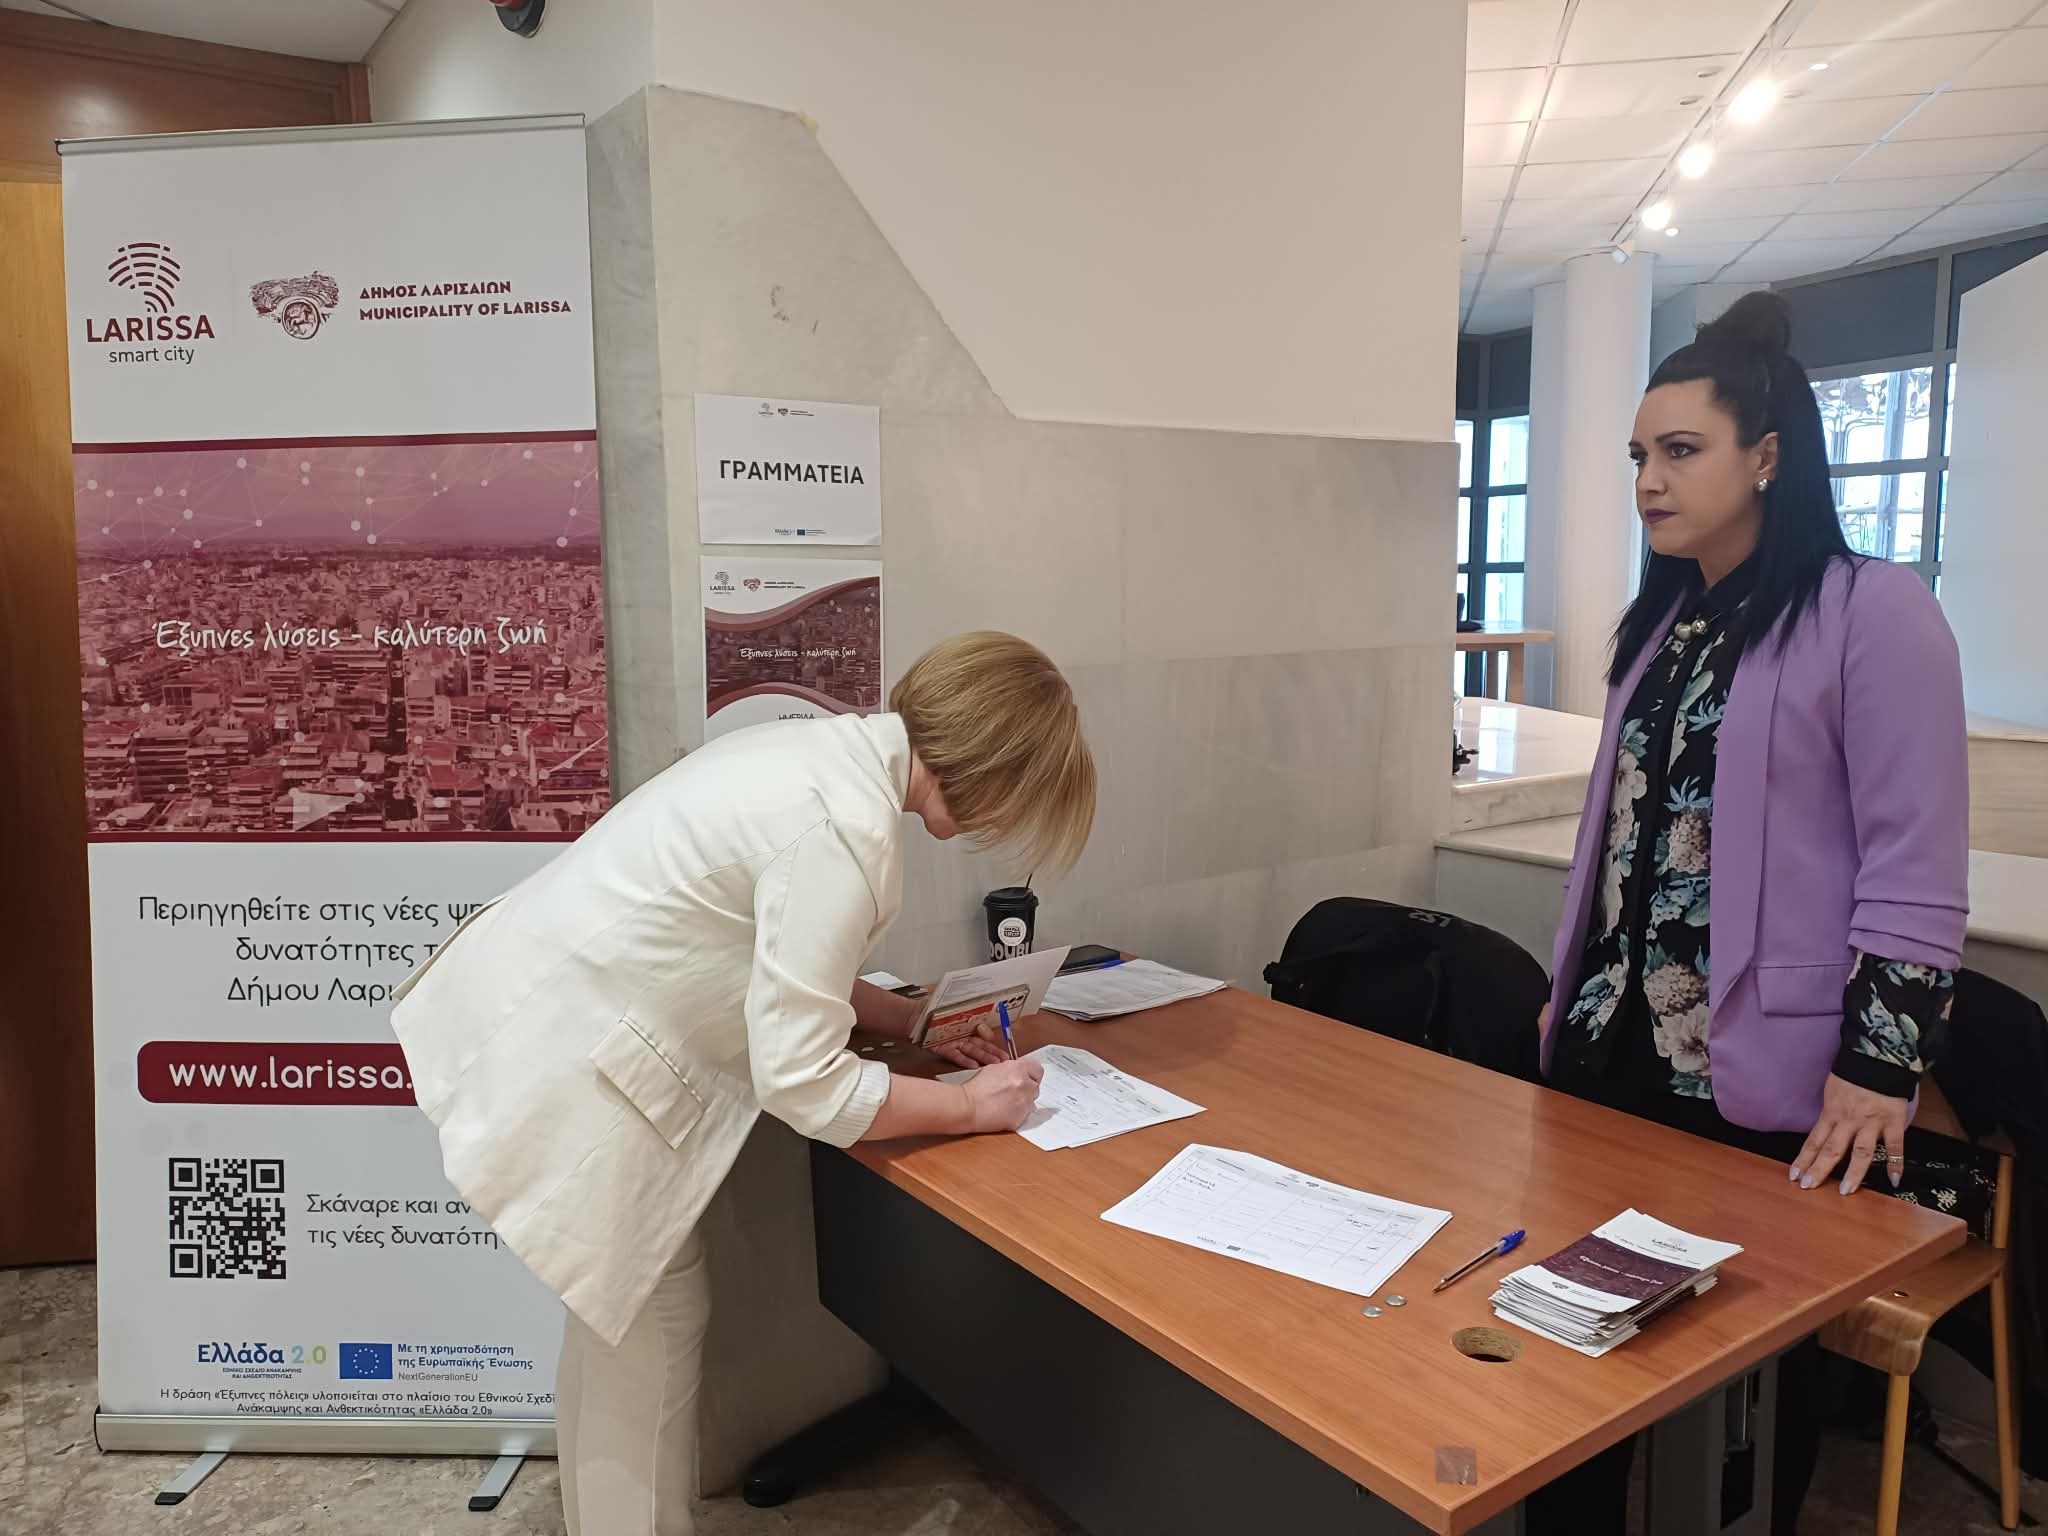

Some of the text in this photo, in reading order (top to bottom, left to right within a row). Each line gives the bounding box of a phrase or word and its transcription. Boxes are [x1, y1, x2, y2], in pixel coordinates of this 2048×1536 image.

[359, 280, 512, 301] ΔΗΜΟΣ ΛΑΡΙΣΑΙΩΝ
[359, 300, 572, 322] MUNICIPALITY OF LARISSA
[86, 313, 216, 343] LARISSA
[108, 345, 195, 366] smart city
[719, 459, 865, 485] ΓΡΑΜΜΑΤΕΙΑ
[150, 619, 256, 655] Έξυπνες
[263, 620, 342, 652] λύσεις
[372, 617, 487, 655] καλύτερη
[495, 616, 548, 654] ζωή
[138, 895, 311, 929] Περιηγηθείτε
[318, 901, 376, 928] στις
[382, 895, 440, 928] νέες
[235, 935, 416, 969] δυνατότητες
[226, 977, 320, 1006] Δήμου
[305, 1193, 400, 1217] Σκάναρε
[404, 1199, 438, 1214] και
[306, 1227, 337, 1249] τις
[341, 1223, 385, 1249] νέες
[197, 1342, 327, 1364] Ελλάδα 2.0
[398, 1344, 514, 1356] Με τη χρηματοδότηση
[398, 1358, 533, 1370] της Ευρωπαϊκής Ένωσης
[398, 1373, 478, 1382] NextGenerationEU
[160, 1389, 170, 1399] Η
[172, 1389, 211, 1400] δράση
[312, 1390, 378, 1401] υλοποιείται
[381, 1393, 403, 1401] στο
[406, 1390, 451, 1401] πλαίσιο
[454, 1394, 475, 1402] του
[478, 1391, 523, 1403] Εθνικού
[236, 1403, 303, 1415] Ανάκαμψης
[304, 1406, 323, 1415] και
[326, 1404, 416, 1417] Ανθεκτικότητας
